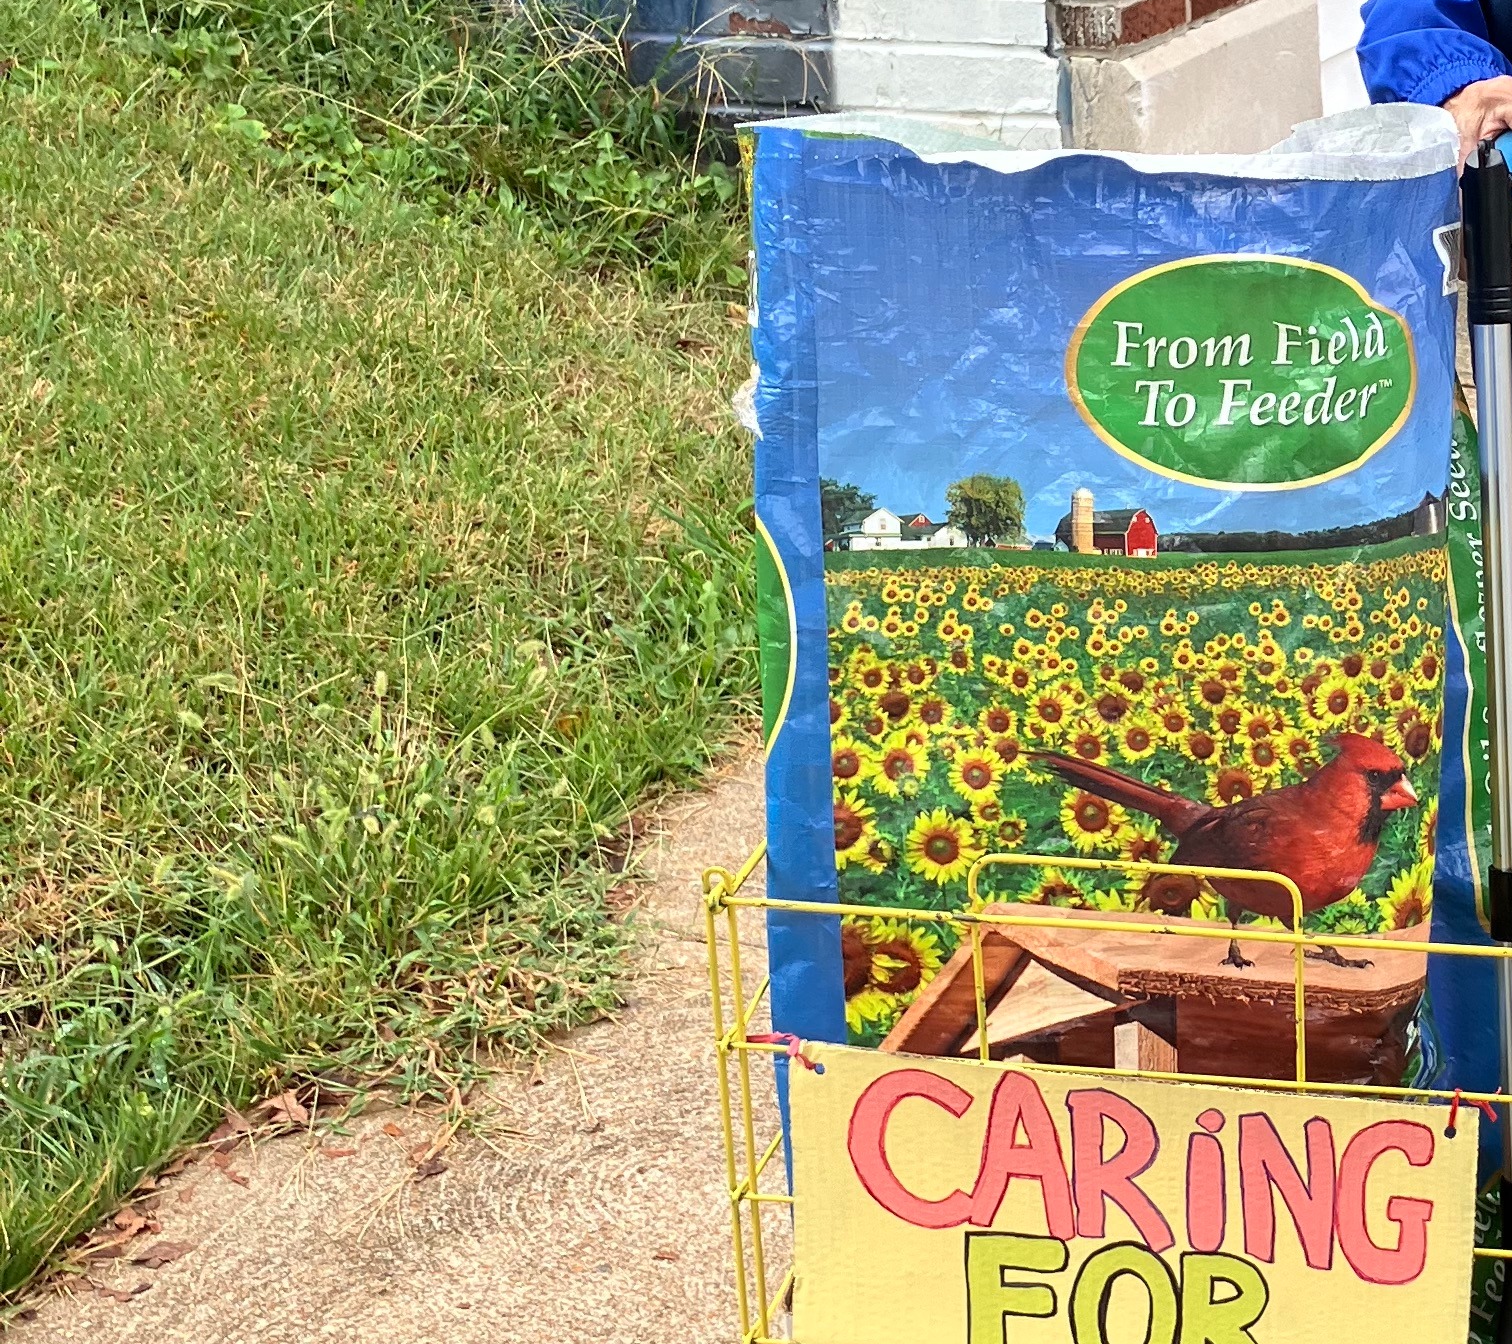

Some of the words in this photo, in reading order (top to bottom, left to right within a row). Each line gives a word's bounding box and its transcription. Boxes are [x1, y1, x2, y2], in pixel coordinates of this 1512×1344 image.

[1110, 320, 1254, 369] From
[1270, 311, 1389, 366] Field
[1134, 379, 1197, 427] To
